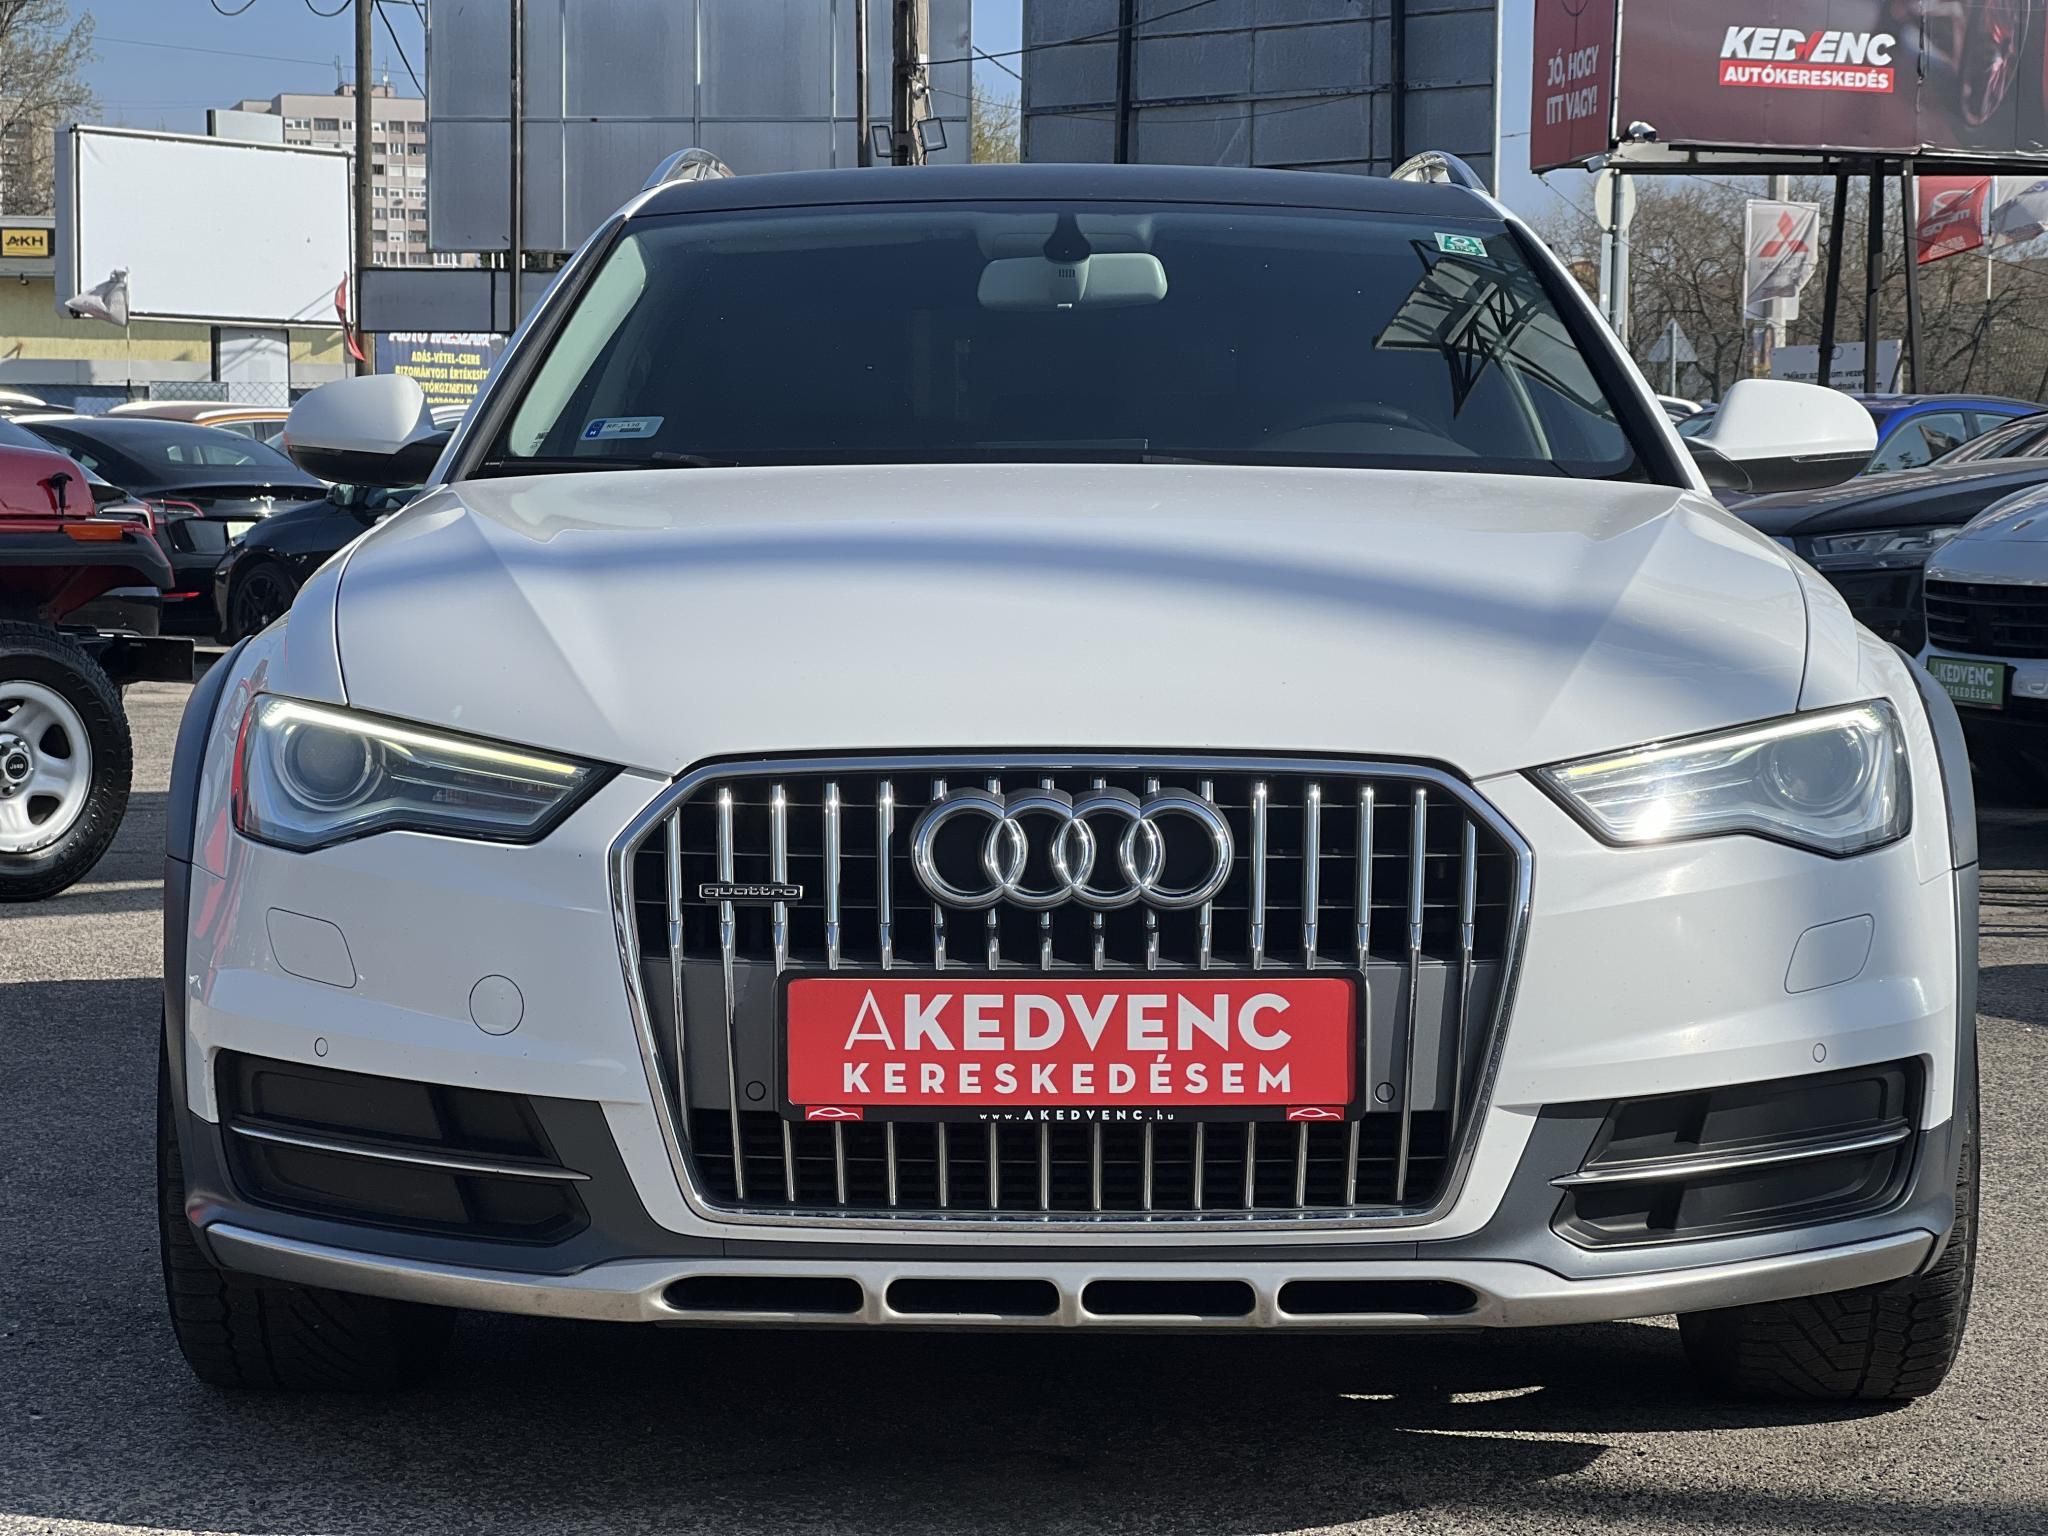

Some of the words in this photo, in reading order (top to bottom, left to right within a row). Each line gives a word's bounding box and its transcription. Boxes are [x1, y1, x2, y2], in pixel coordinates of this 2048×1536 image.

[1720, 26, 1896, 65] KEDVENC
[1547, 48, 1565, 88] JÓ,
[1568, 44, 1599, 80] HOGY
[1724, 65, 1889, 88] AUTÓKERESKEDÉS
[1546, 95, 1564, 125] ITT
[1566, 85, 1598, 120] VAGY!
[5, 235, 43, 247] AKH
[449, 367, 490, 380] ÉRTÉKESÍT
[419, 380, 479, 394] UTÓKOZMETIKA
[704, 886, 798, 897] quattro
[843, 1054, 1291, 1094] KERESKEDÉSEM
[979, 1110, 1175, 1121] www.AKEDVENC.hu
